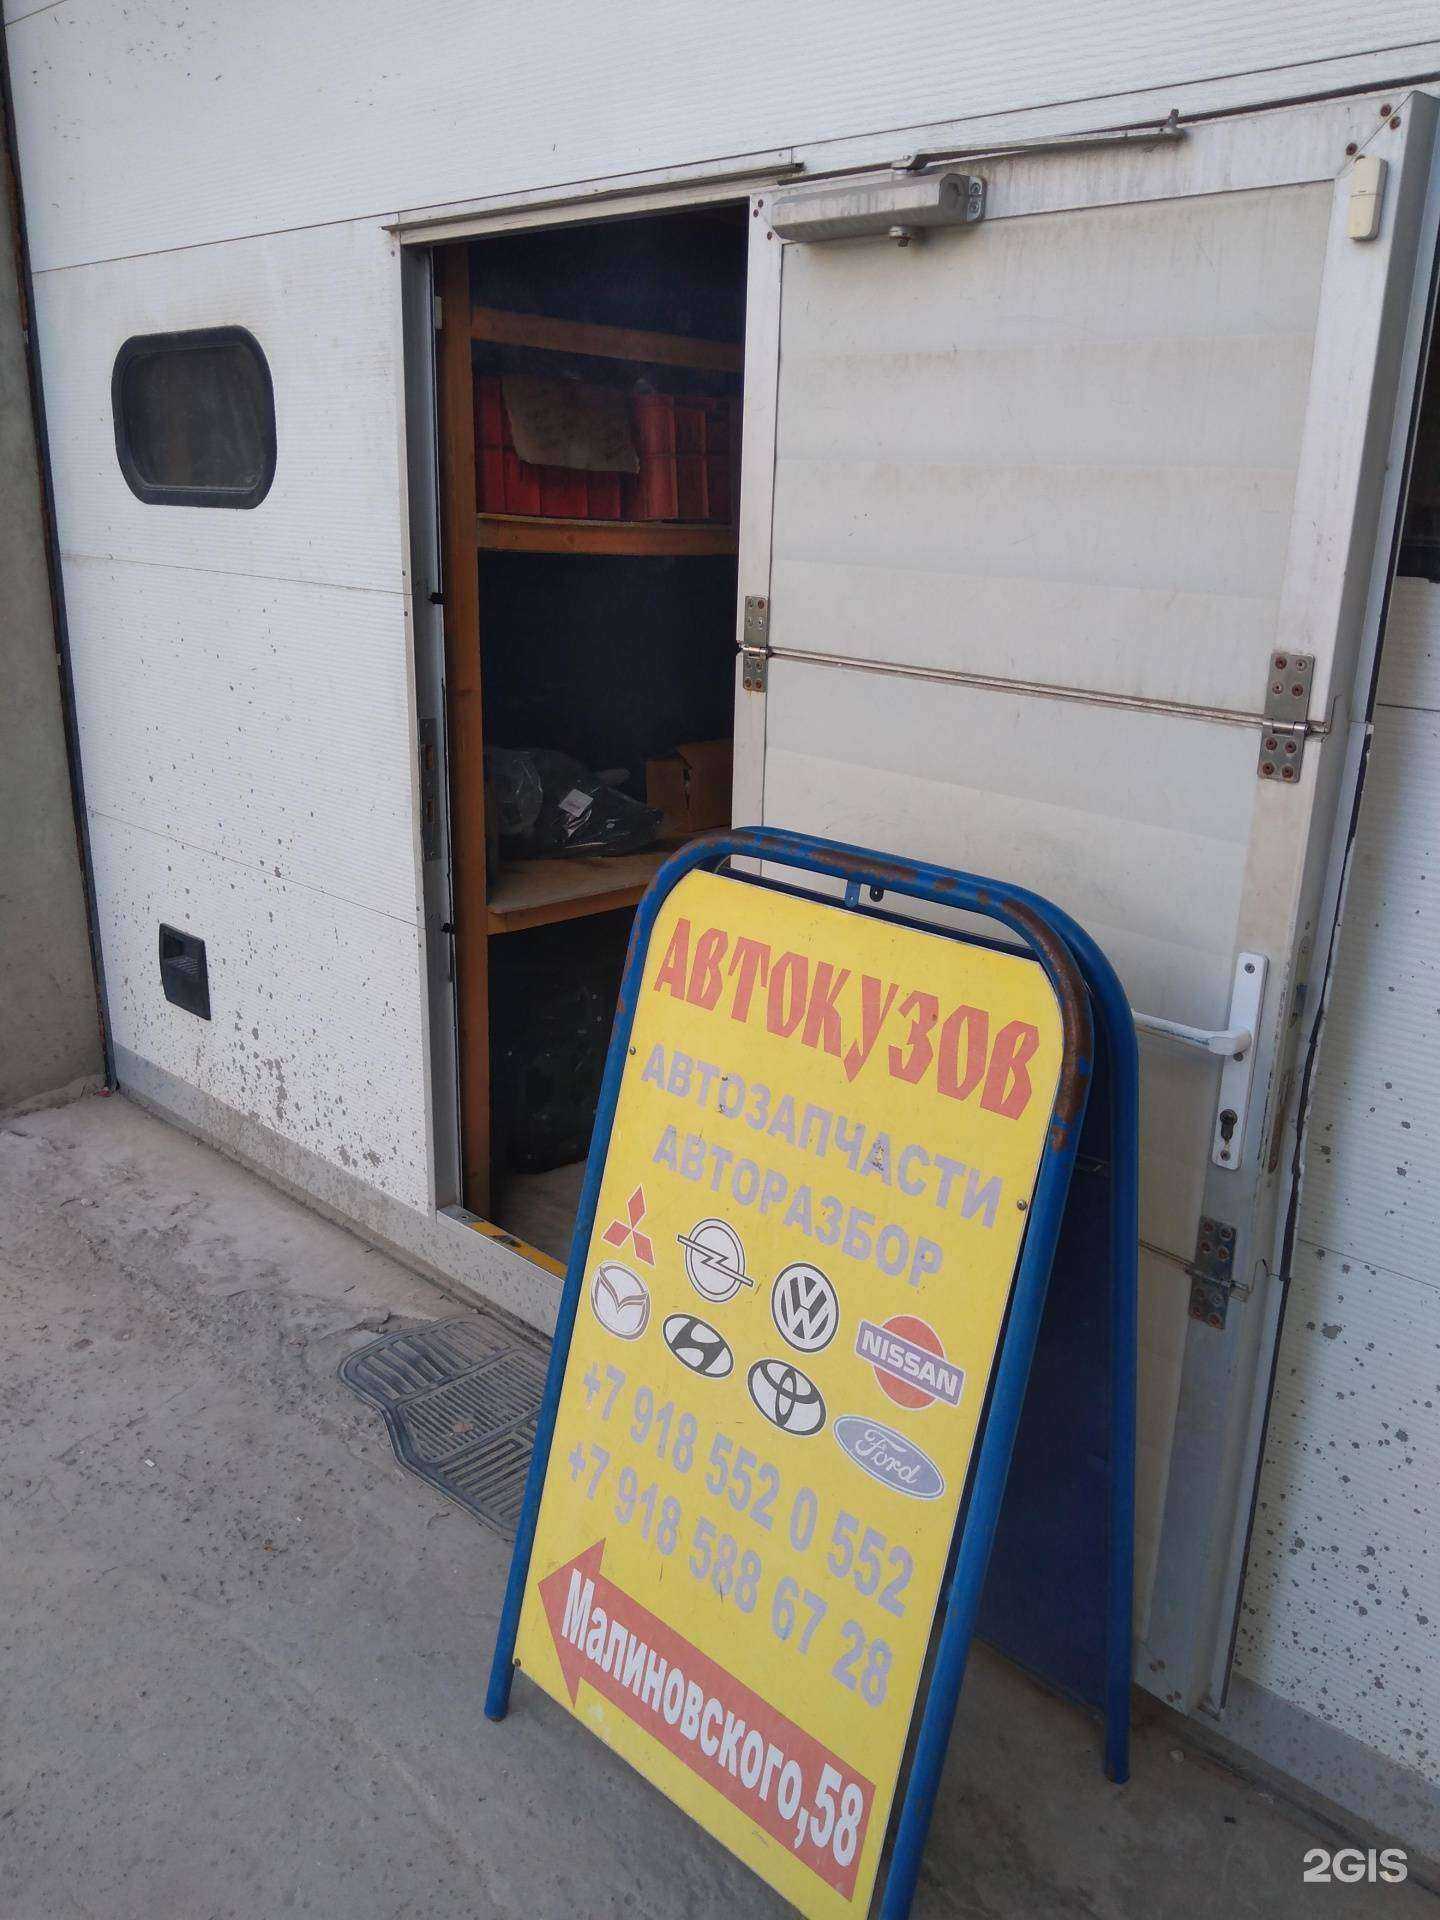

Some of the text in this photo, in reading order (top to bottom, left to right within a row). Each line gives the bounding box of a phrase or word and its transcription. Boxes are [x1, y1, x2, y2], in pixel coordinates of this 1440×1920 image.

[653, 917, 1040, 1121] АВТОКУЗОВ
[641, 1043, 1003, 1229] АВТОЗАПЧАСТИ
[652, 1125, 944, 1287] АВТОРАЗБОР
[855, 1428, 921, 1484] Ford
[861, 1329, 958, 1397] NISSAN
[568, 1441, 893, 1707] +7 918 588 67 28
[583, 1361, 914, 1618] +7 918 552 0 552
